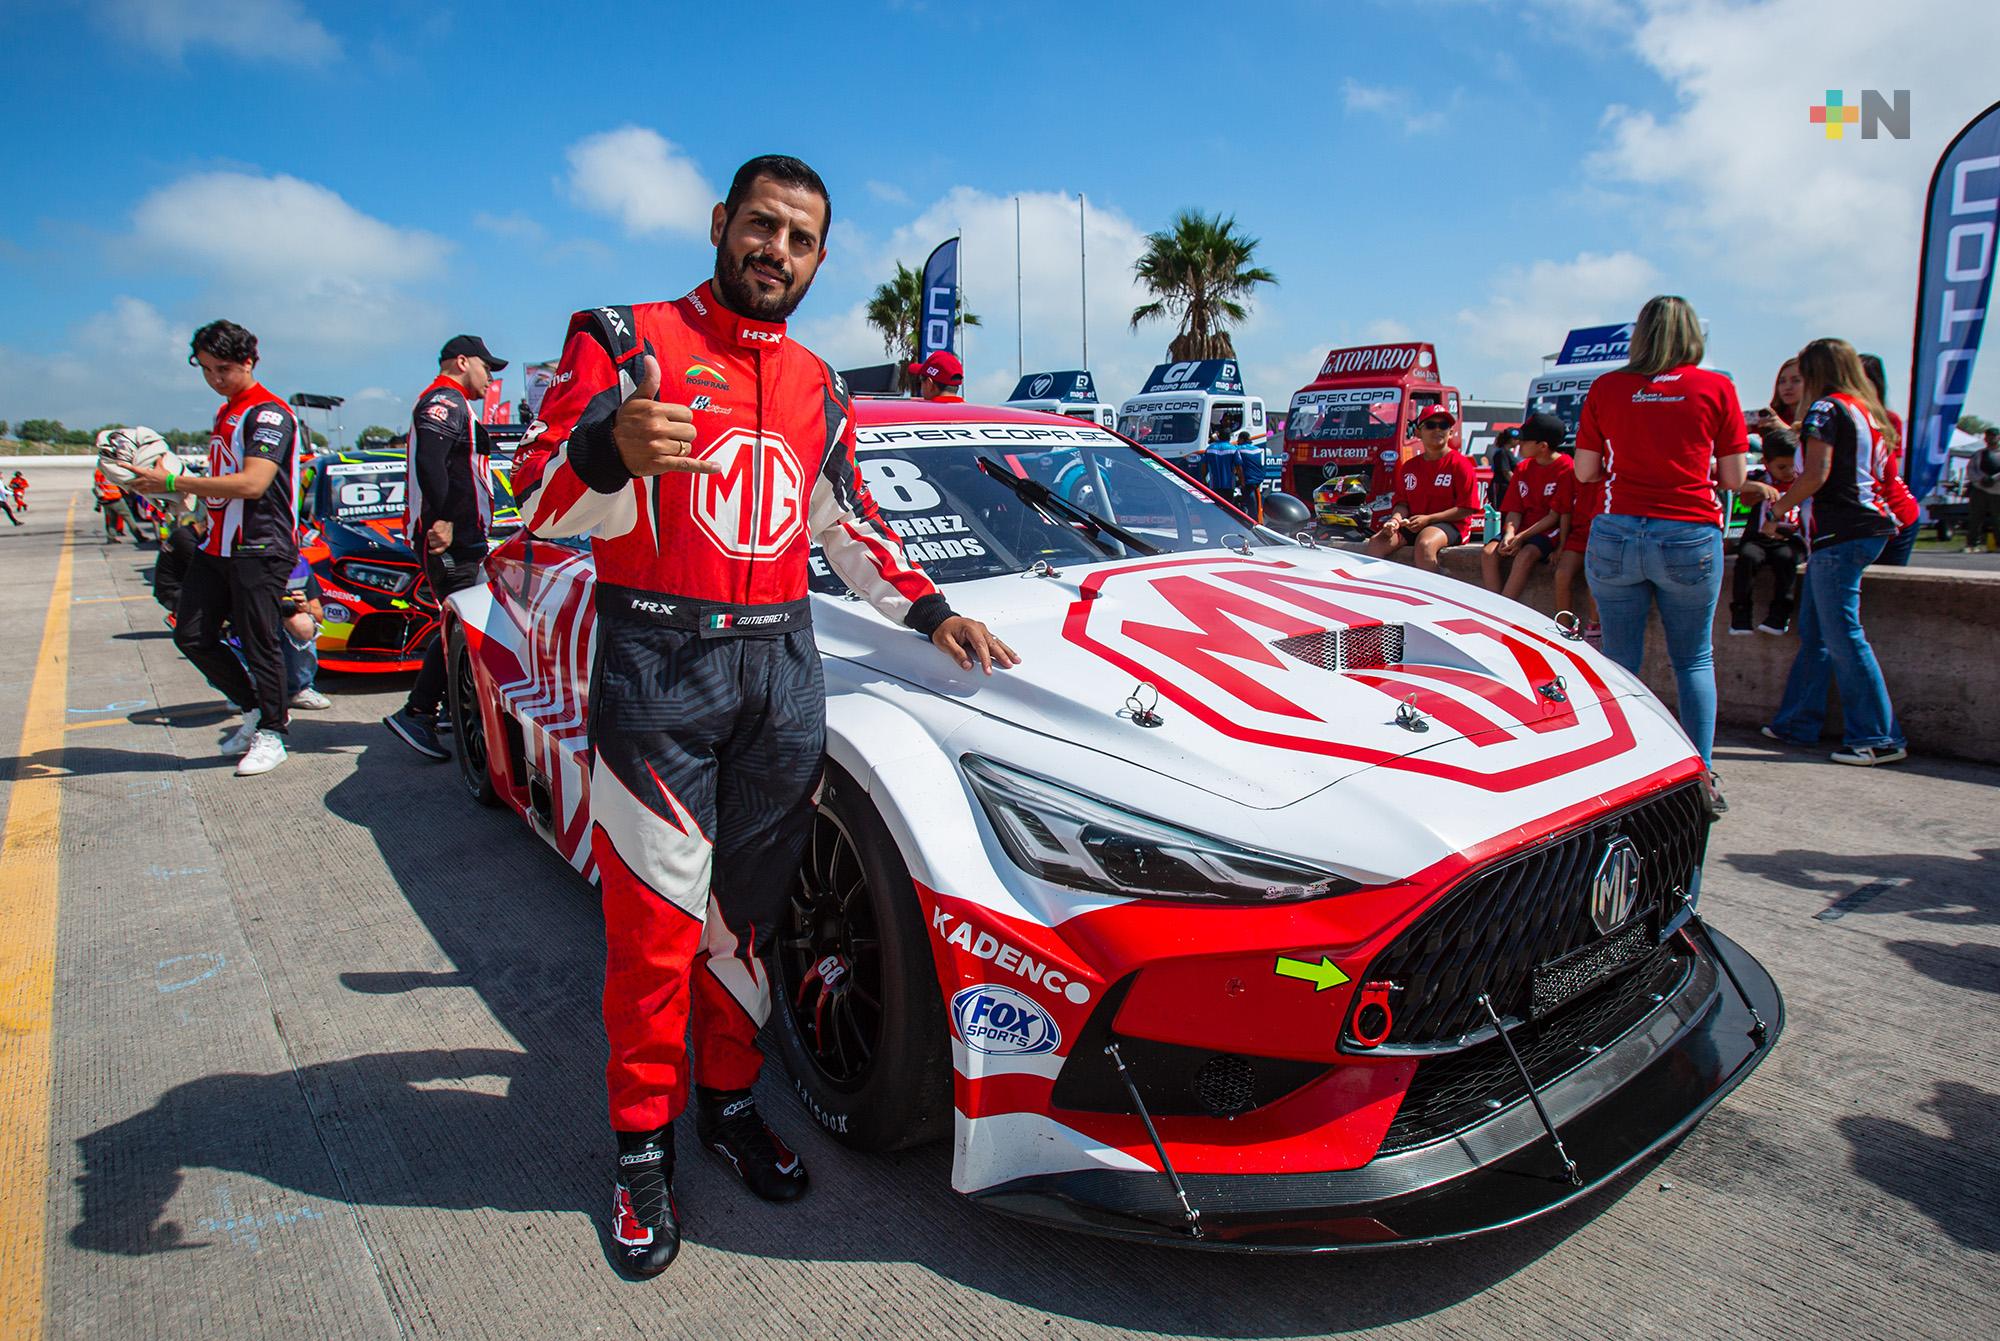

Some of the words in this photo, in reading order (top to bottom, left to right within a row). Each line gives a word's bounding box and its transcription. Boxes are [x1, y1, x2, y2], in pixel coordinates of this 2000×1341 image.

[742, 329, 783, 344] HRX
[1321, 348, 1417, 375] GATOPARDO
[1163, 361, 1202, 384] GI
[1150, 383, 1178, 392] GRUPO
[1536, 380, 1591, 394] SÚPE
[1297, 393, 1348, 405] SÚPER
[1350, 391, 1394, 402] COPA
[1125, 403, 1163, 413] SÚPER
[1165, 402, 1199, 410] COPA
[257, 410, 284, 426] 68
[1103, 415, 1113, 425] 12
[857, 429, 977, 444] ÚPER
[979, 429, 1075, 440] COPA
[1076, 431, 1113, 441] SC
[1322, 427, 1363, 437] FOTON
[1434, 473, 1453, 487] 68
[341, 481, 406, 507] 67
[704, 442, 798, 548] MG
[888, 515, 970, 537] RREZ
[904, 538, 986, 562] ARDS
[631, 599, 677, 616] HRX
[737, 613, 783, 625] GUTIERREZ
[1598, 845, 1640, 928] MG
[933, 905, 1091, 1004] KADENCO
[818, 955, 845, 985] 68
[971, 995, 1040, 1038] FOX
[966, 1024, 1030, 1048] SPORTS
